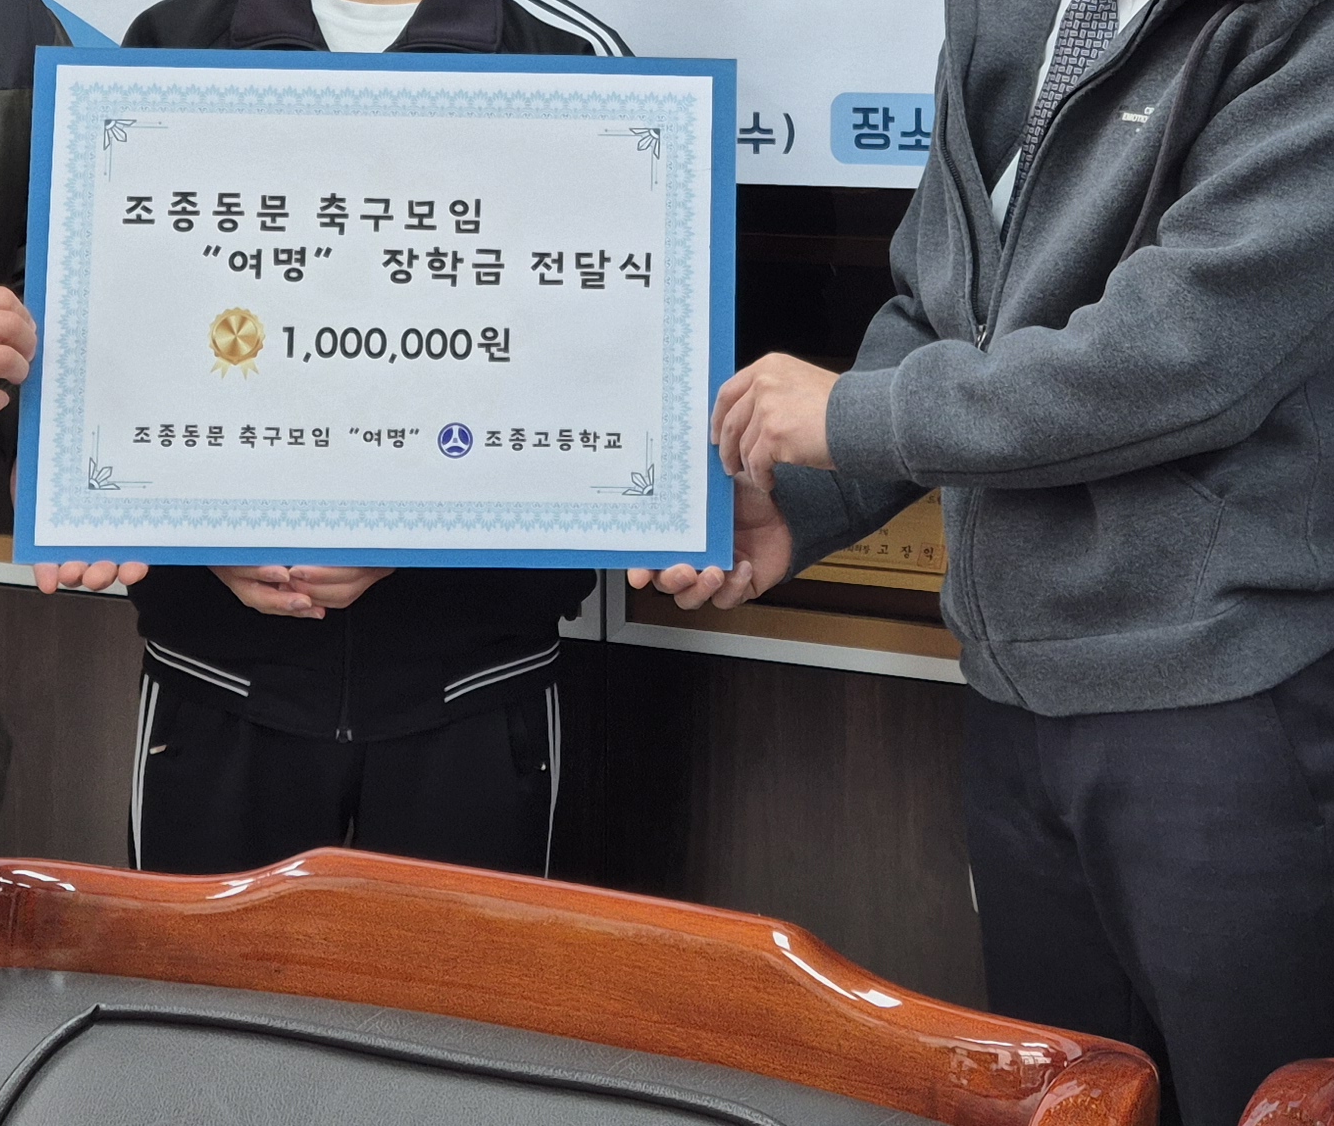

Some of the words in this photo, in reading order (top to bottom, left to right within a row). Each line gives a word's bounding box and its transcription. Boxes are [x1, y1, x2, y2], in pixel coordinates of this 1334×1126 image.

[122, 191, 290, 233] 조종동문
[316, 192, 481, 236] 축구모임
[382, 246, 505, 287] 장학금
[531, 249, 652, 290] 전달식
[282, 326, 511, 364] 1,000,000원
[133, 423, 225, 448] 조종동문
[239, 424, 330, 449] 축구모임
[484, 427, 623, 452] 조종고등학교
